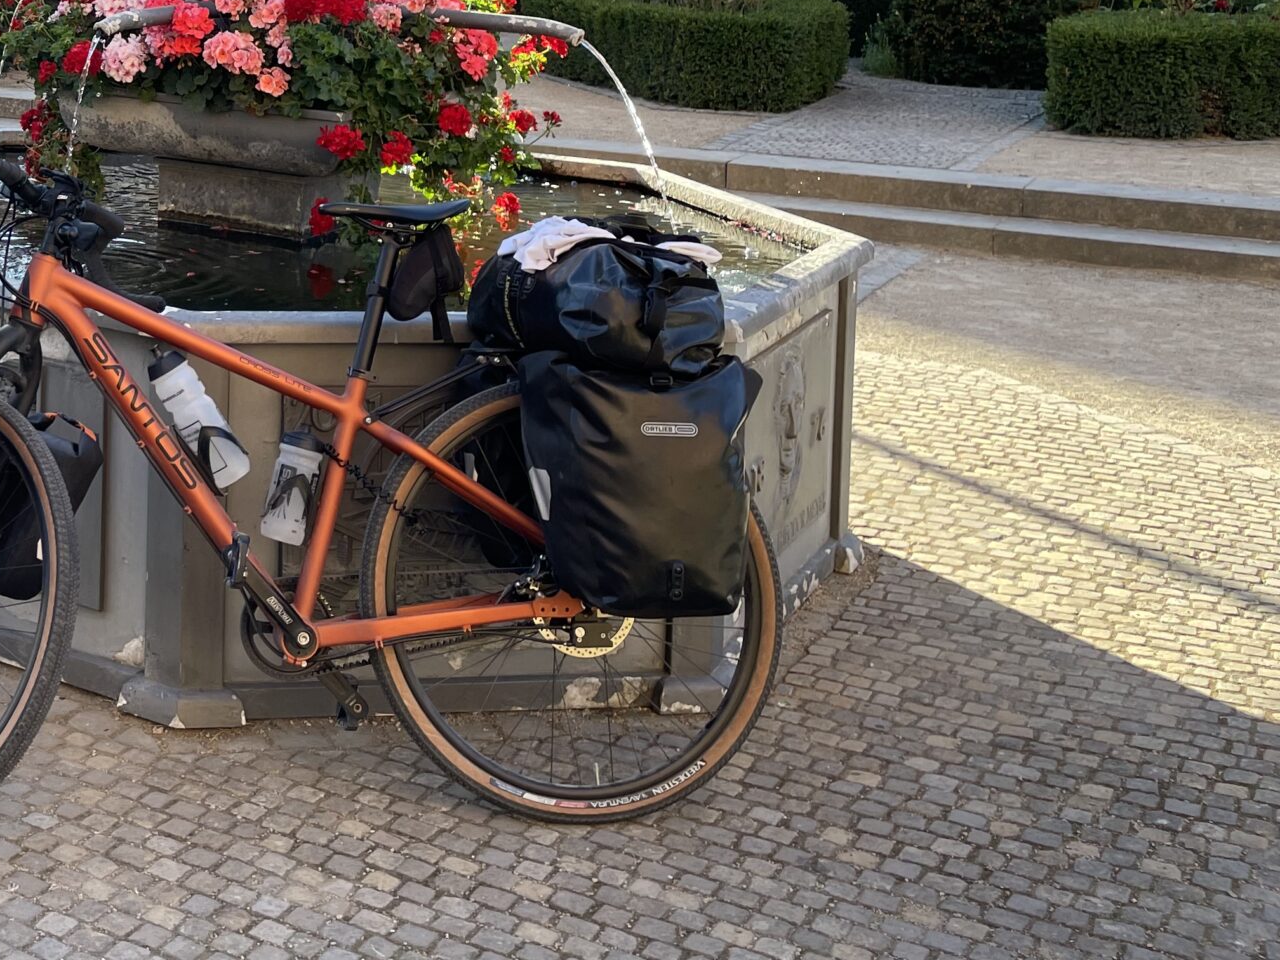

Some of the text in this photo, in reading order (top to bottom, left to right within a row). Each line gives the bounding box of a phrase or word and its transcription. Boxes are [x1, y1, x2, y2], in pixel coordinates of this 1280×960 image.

[82, 332, 197, 490] SANTOS
[645, 425, 673, 433] ORTLIEB
[651, 759, 706, 796] VREDESTEIN
